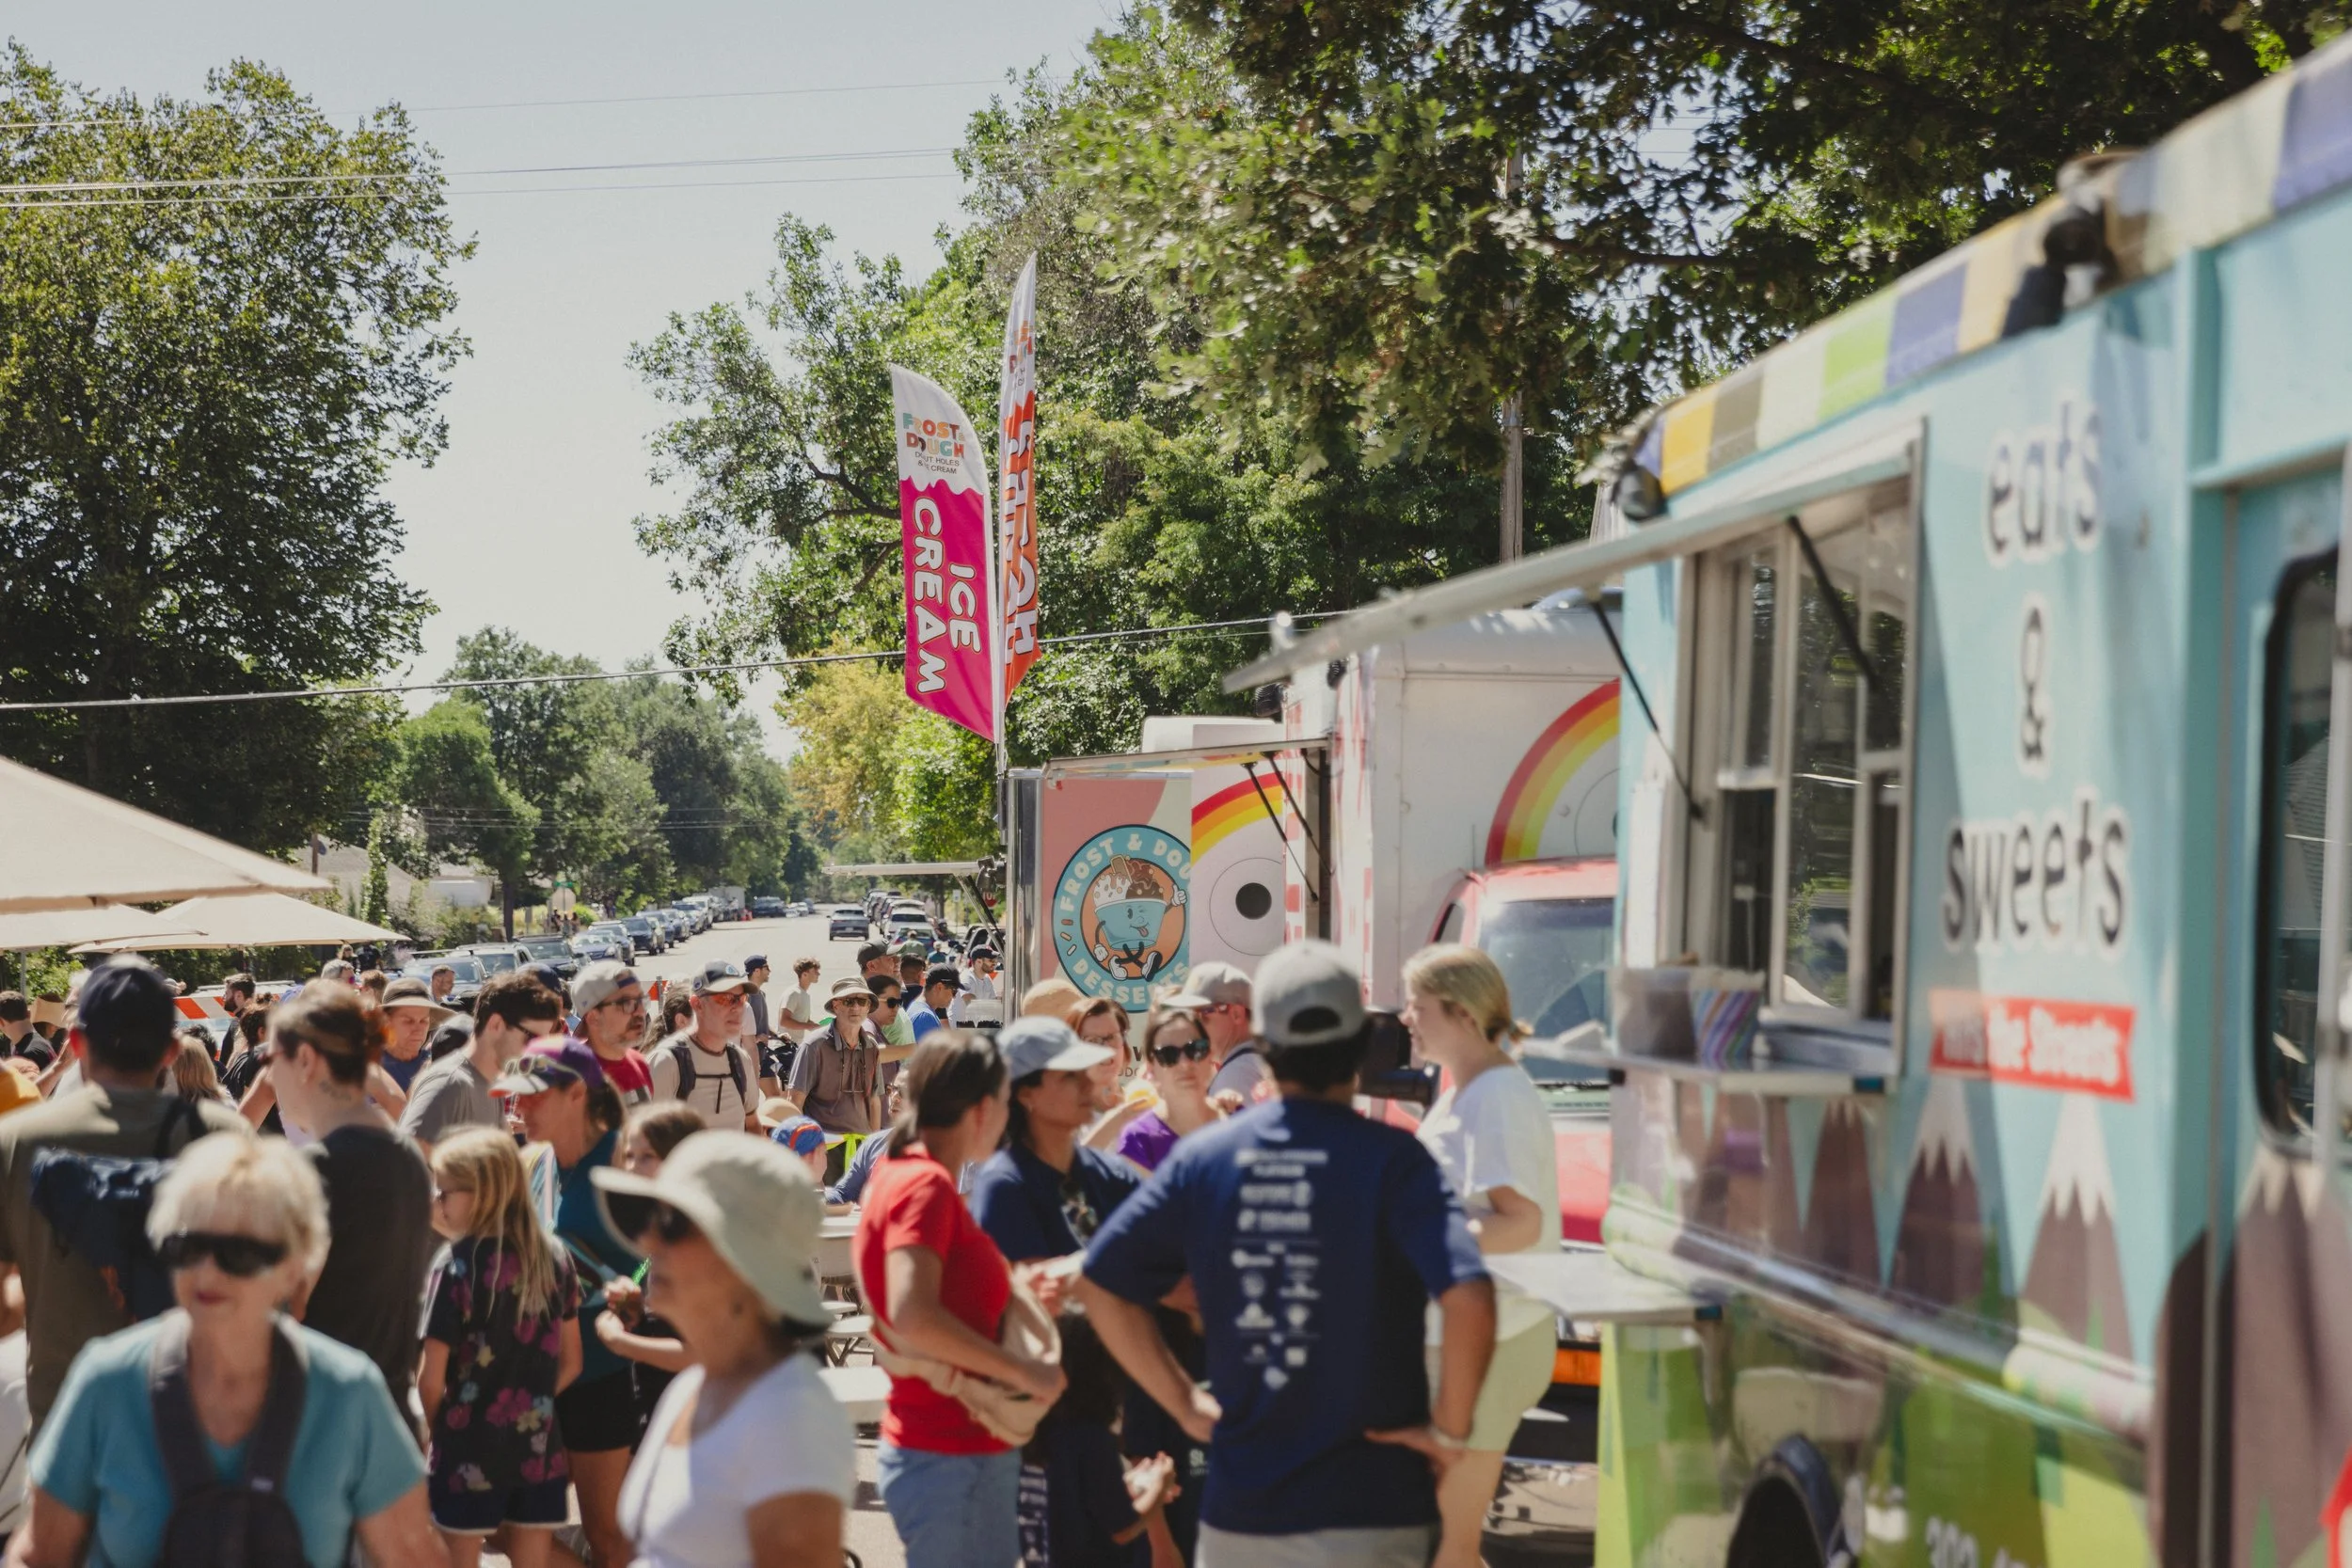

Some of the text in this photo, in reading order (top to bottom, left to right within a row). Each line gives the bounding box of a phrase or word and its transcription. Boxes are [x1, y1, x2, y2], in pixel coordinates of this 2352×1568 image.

[903, 412, 960, 439] FROST
[935, 457, 960, 467] HOLES
[914, 497, 947, 694] CREAM
[948, 563, 981, 654] ICE
[1059, 837, 1114, 911] FROST
[1127, 833, 1142, 851] &
[1942, 798, 2126, 947] sweets
[1073, 958, 1189, 1004] DESSETS
